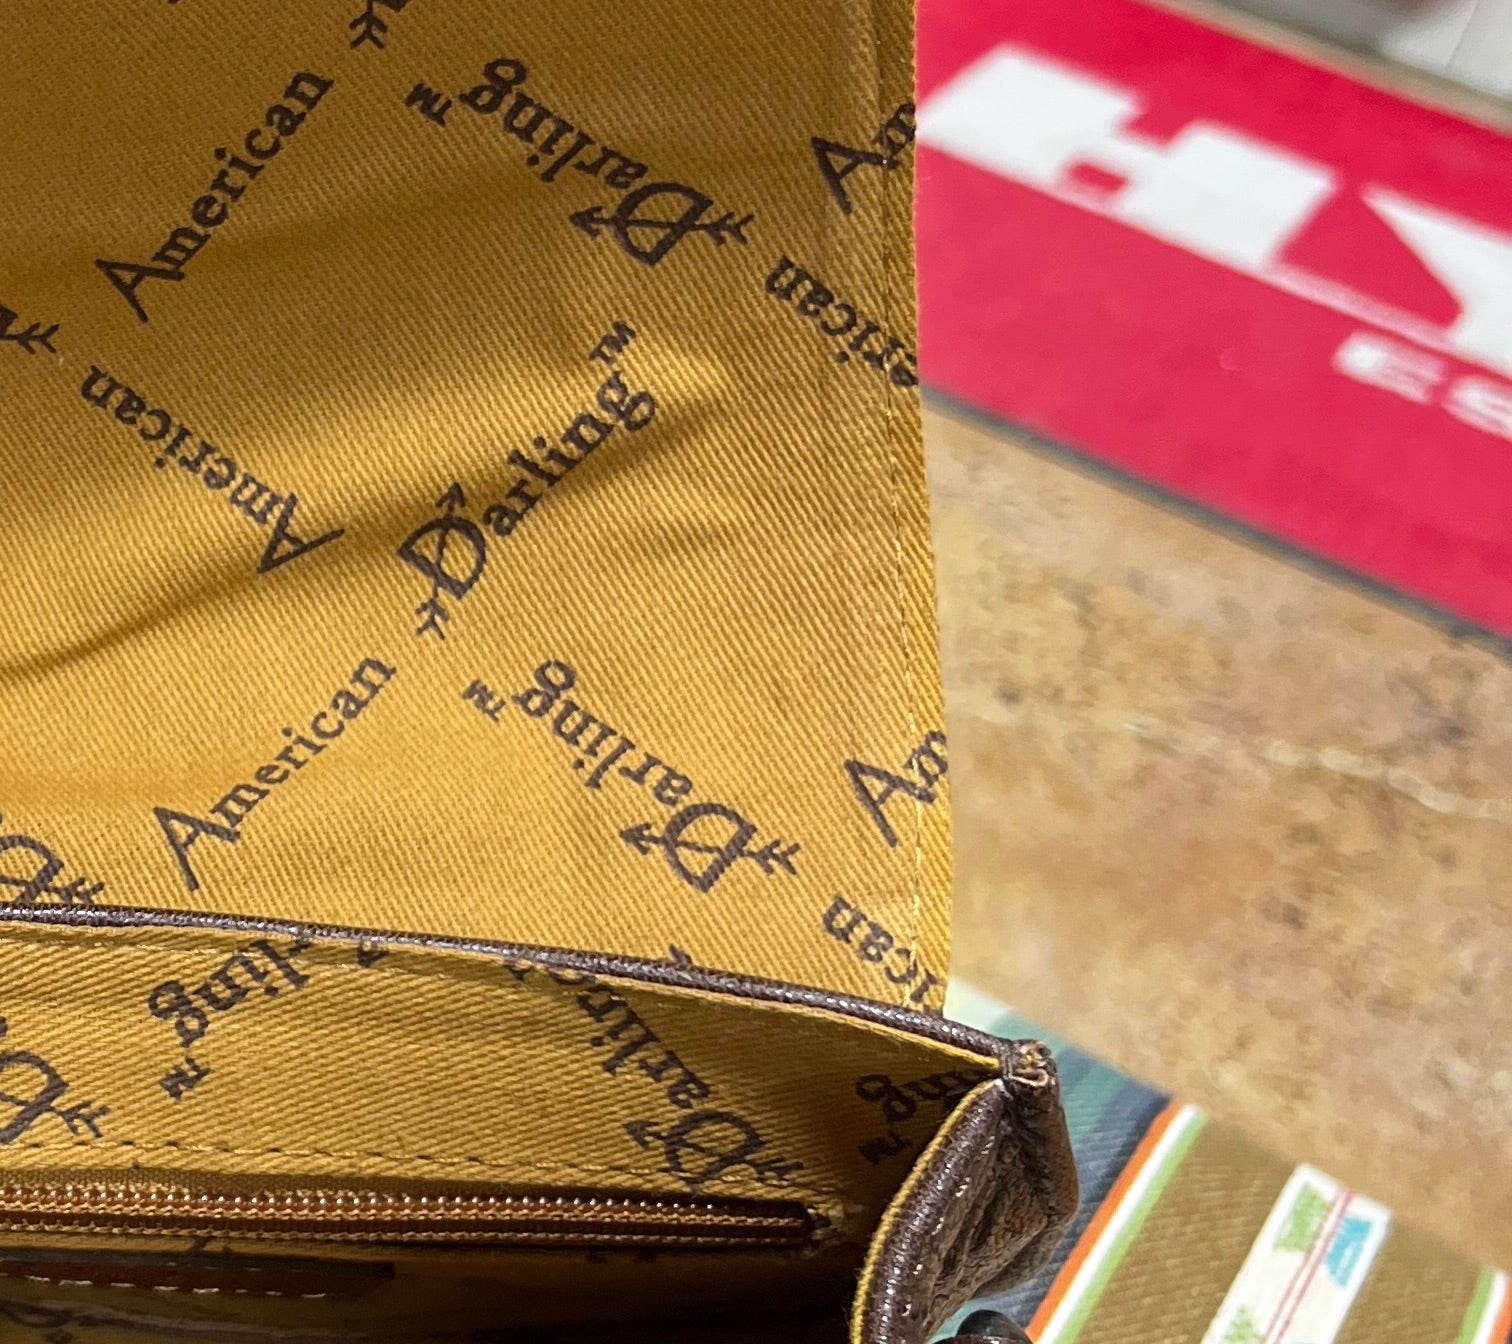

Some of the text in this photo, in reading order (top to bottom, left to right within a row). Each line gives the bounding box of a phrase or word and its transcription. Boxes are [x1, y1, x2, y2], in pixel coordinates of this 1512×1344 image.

[97, 69, 334, 323] American
[81, 365, 343, 574] American
[152, 655, 396, 893] American
